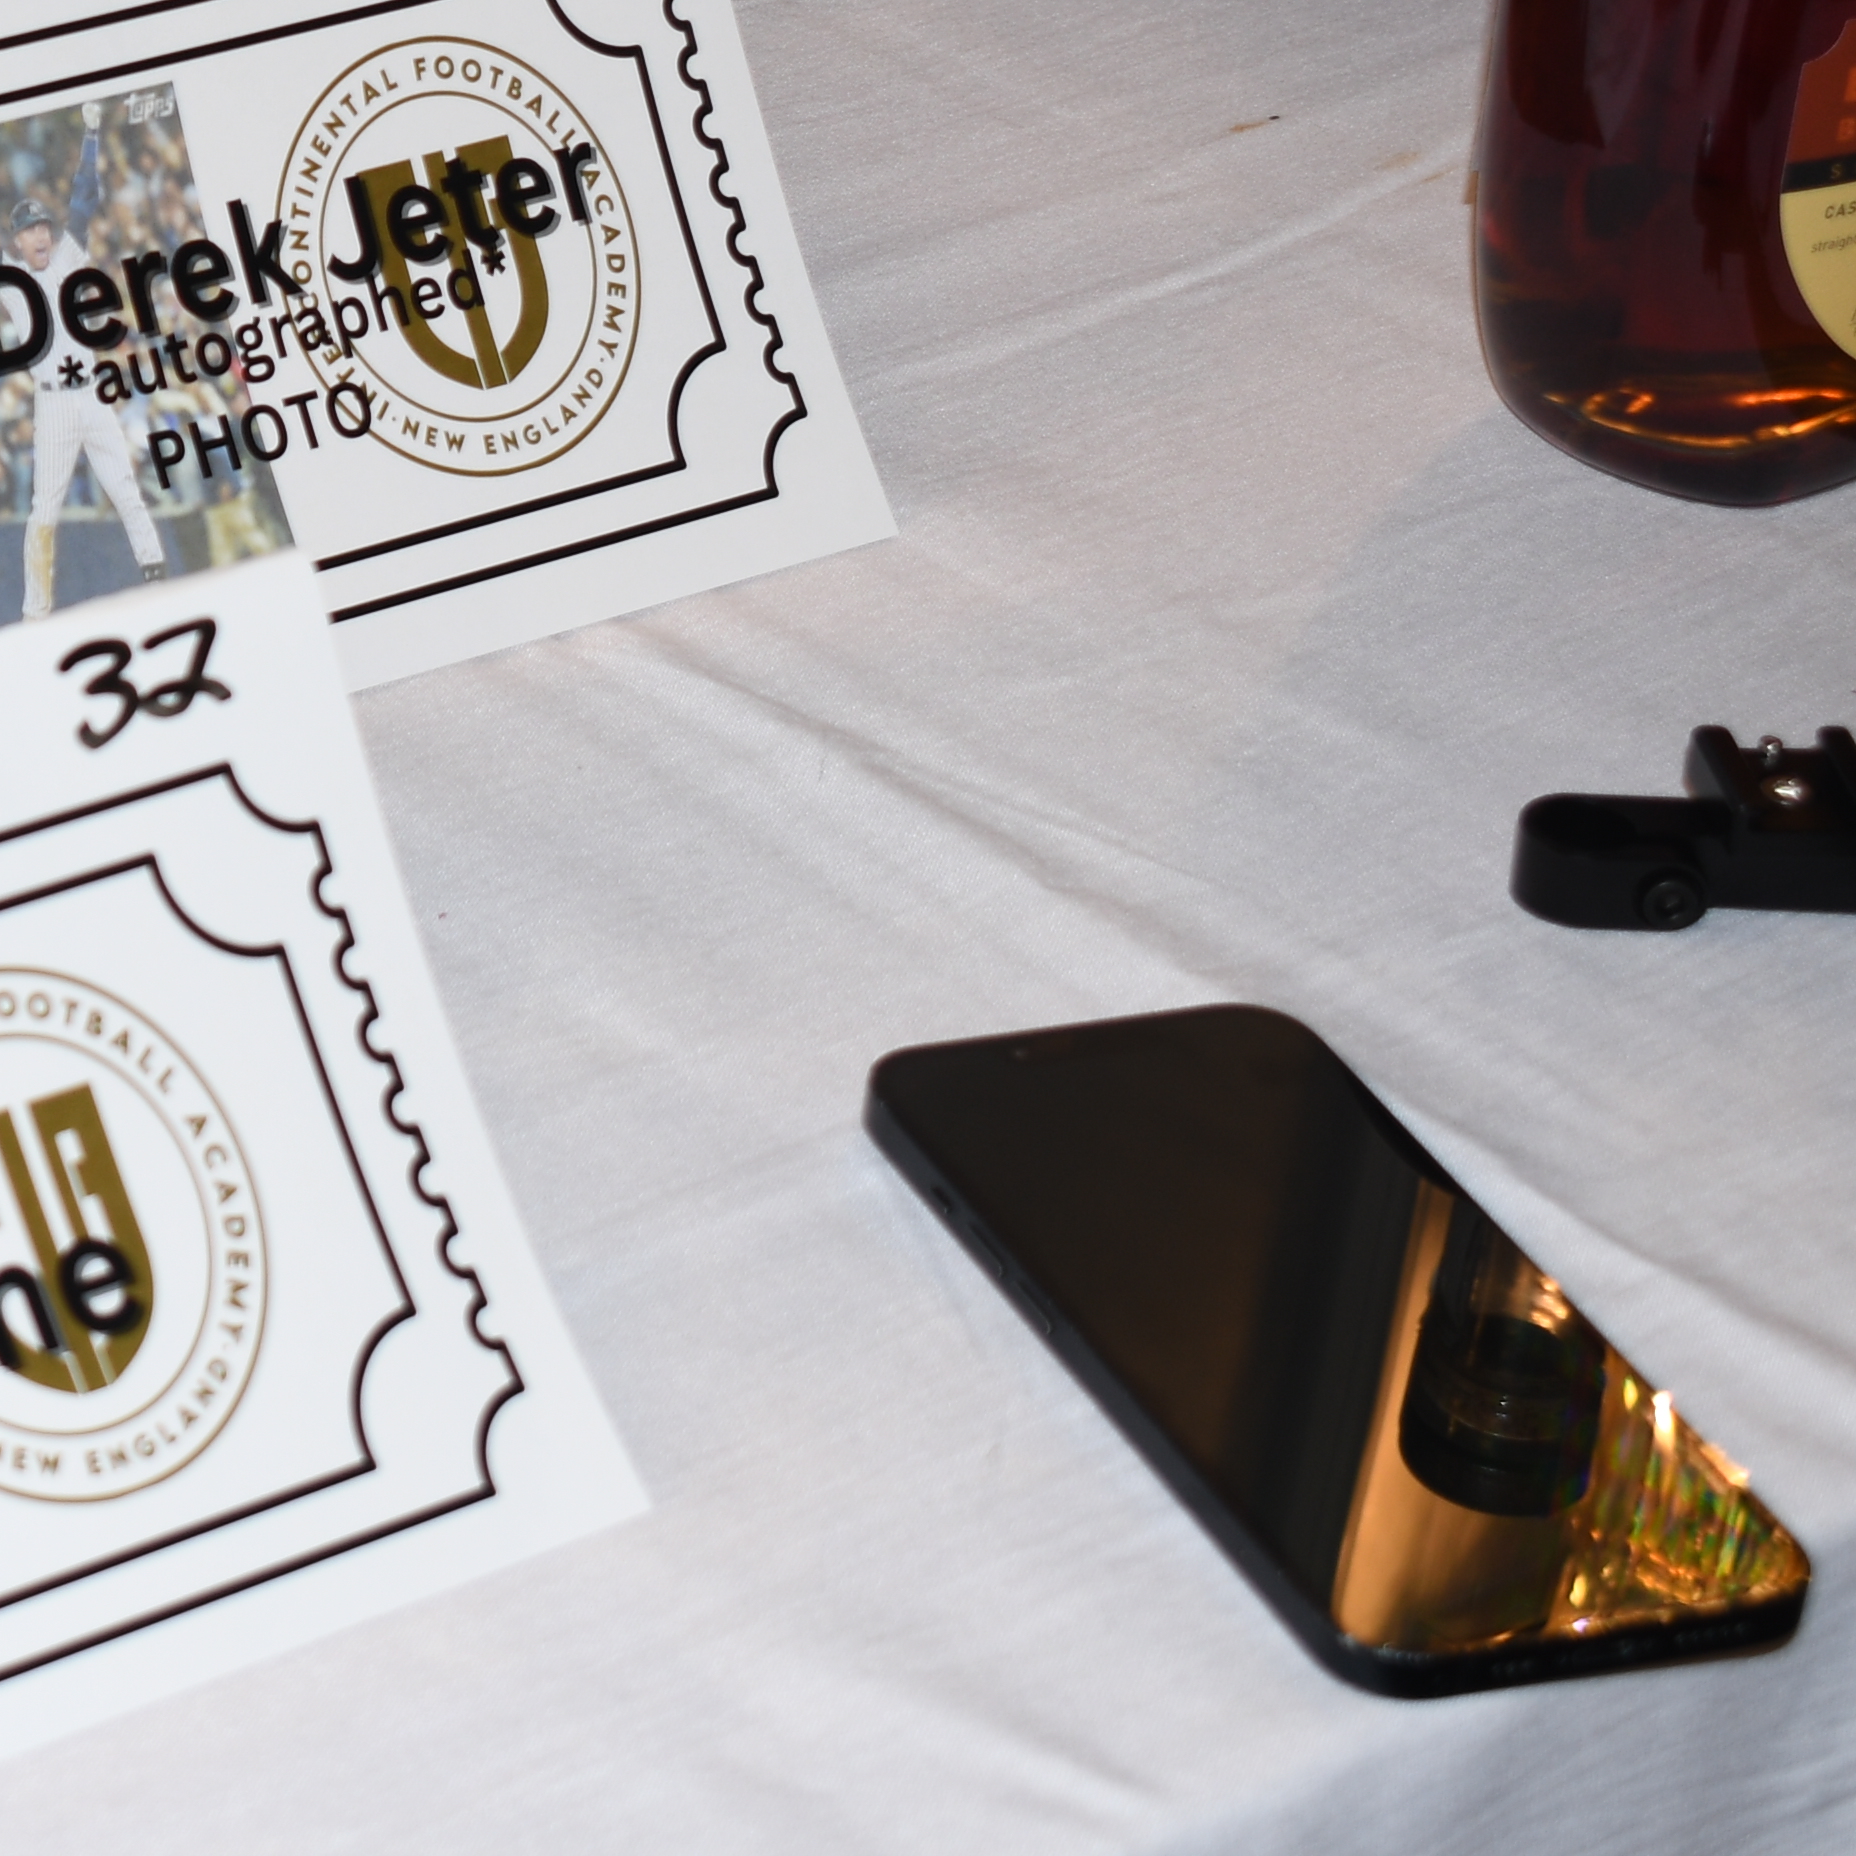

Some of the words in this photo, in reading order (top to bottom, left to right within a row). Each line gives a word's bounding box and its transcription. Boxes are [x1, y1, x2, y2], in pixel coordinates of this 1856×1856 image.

[327, 142, 596, 283] Jeter
[412, 55, 578, 150] FOOTBALL
[579, 168, 628, 360] ACADEMY
[148, 382, 372, 490] PHOTO
[400, 415, 466, 454] NEW
[482, 367, 604, 456] ENGLAND
[59, 617, 233, 750] 32
[185, 1111, 253, 1345] ACADEMY
[86, 1354, 230, 1476] ENGLAND
